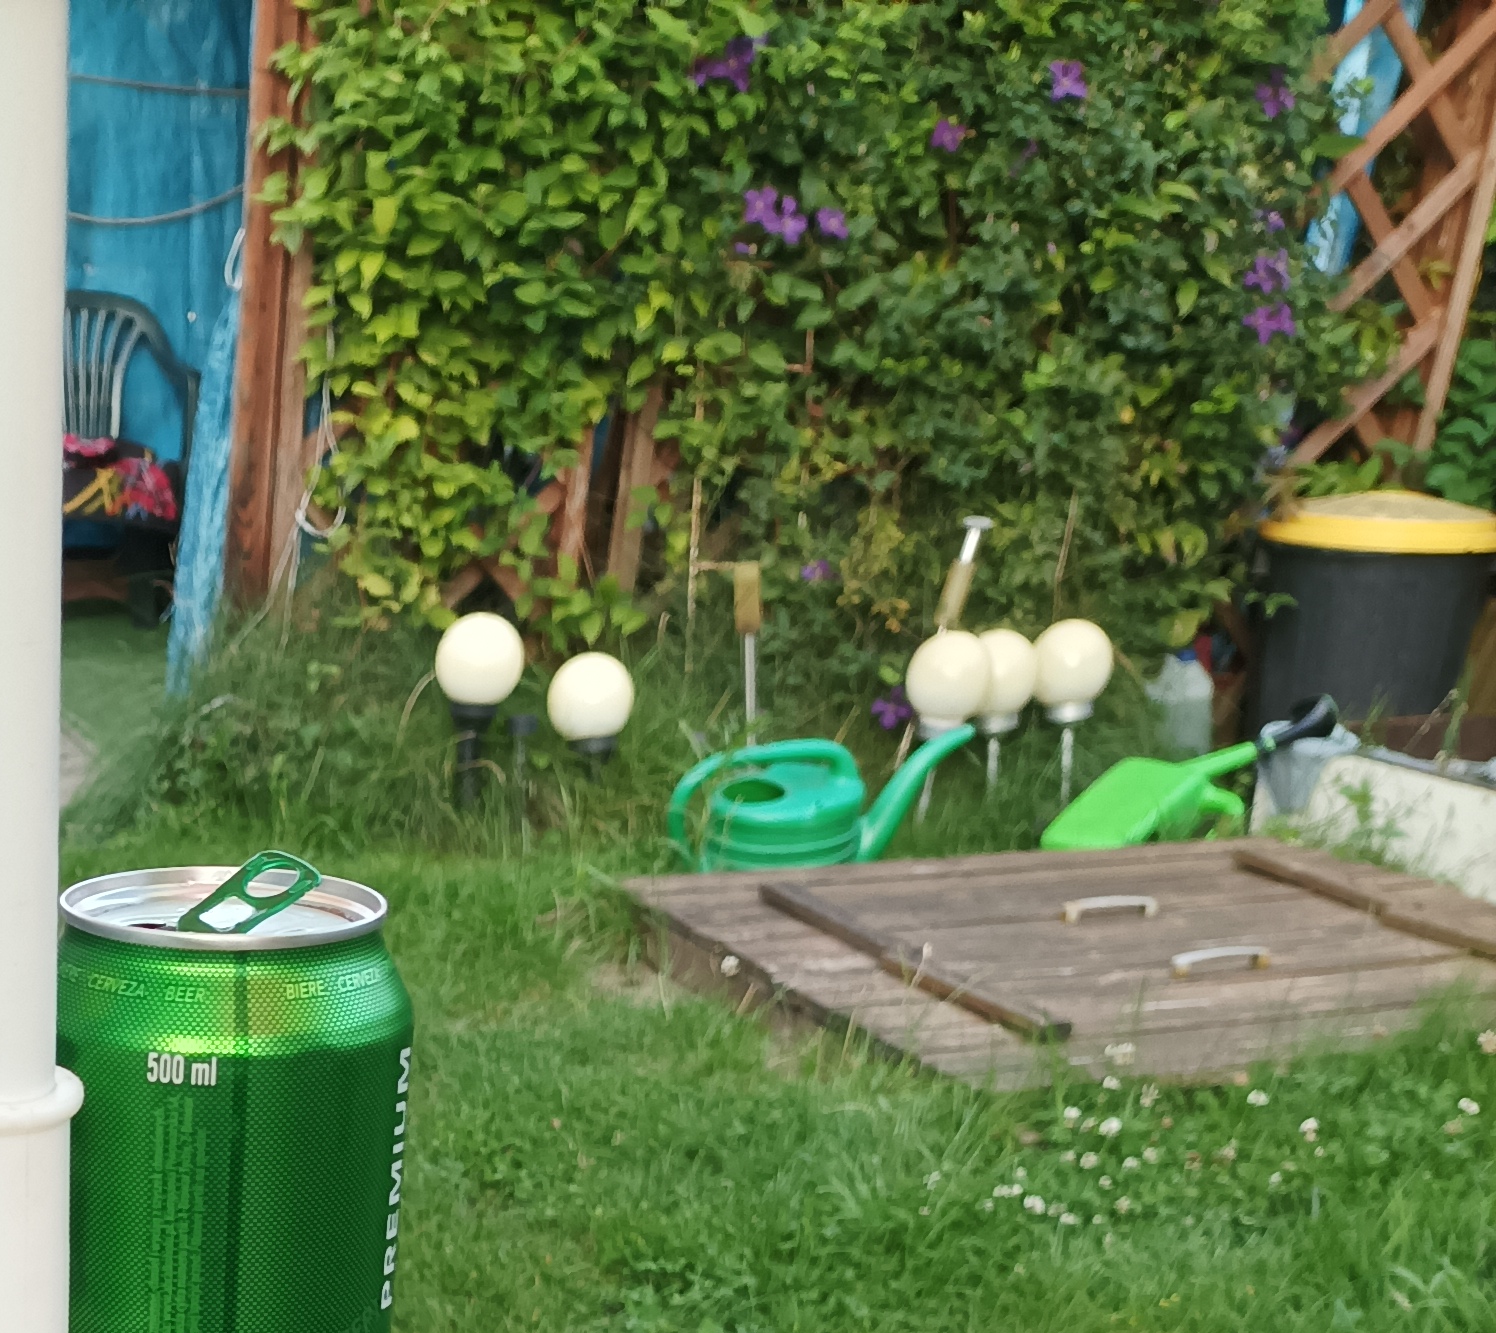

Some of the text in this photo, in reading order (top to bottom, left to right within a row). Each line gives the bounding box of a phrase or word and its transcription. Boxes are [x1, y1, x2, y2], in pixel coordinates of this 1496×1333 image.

[87, 973, 205, 1002] CERVEZA BEER
[286, 980, 326, 1000] BIERE
[147, 1051, 218, 1087] 500 ml
[380, 1046, 412, 1310] PREMIUM
